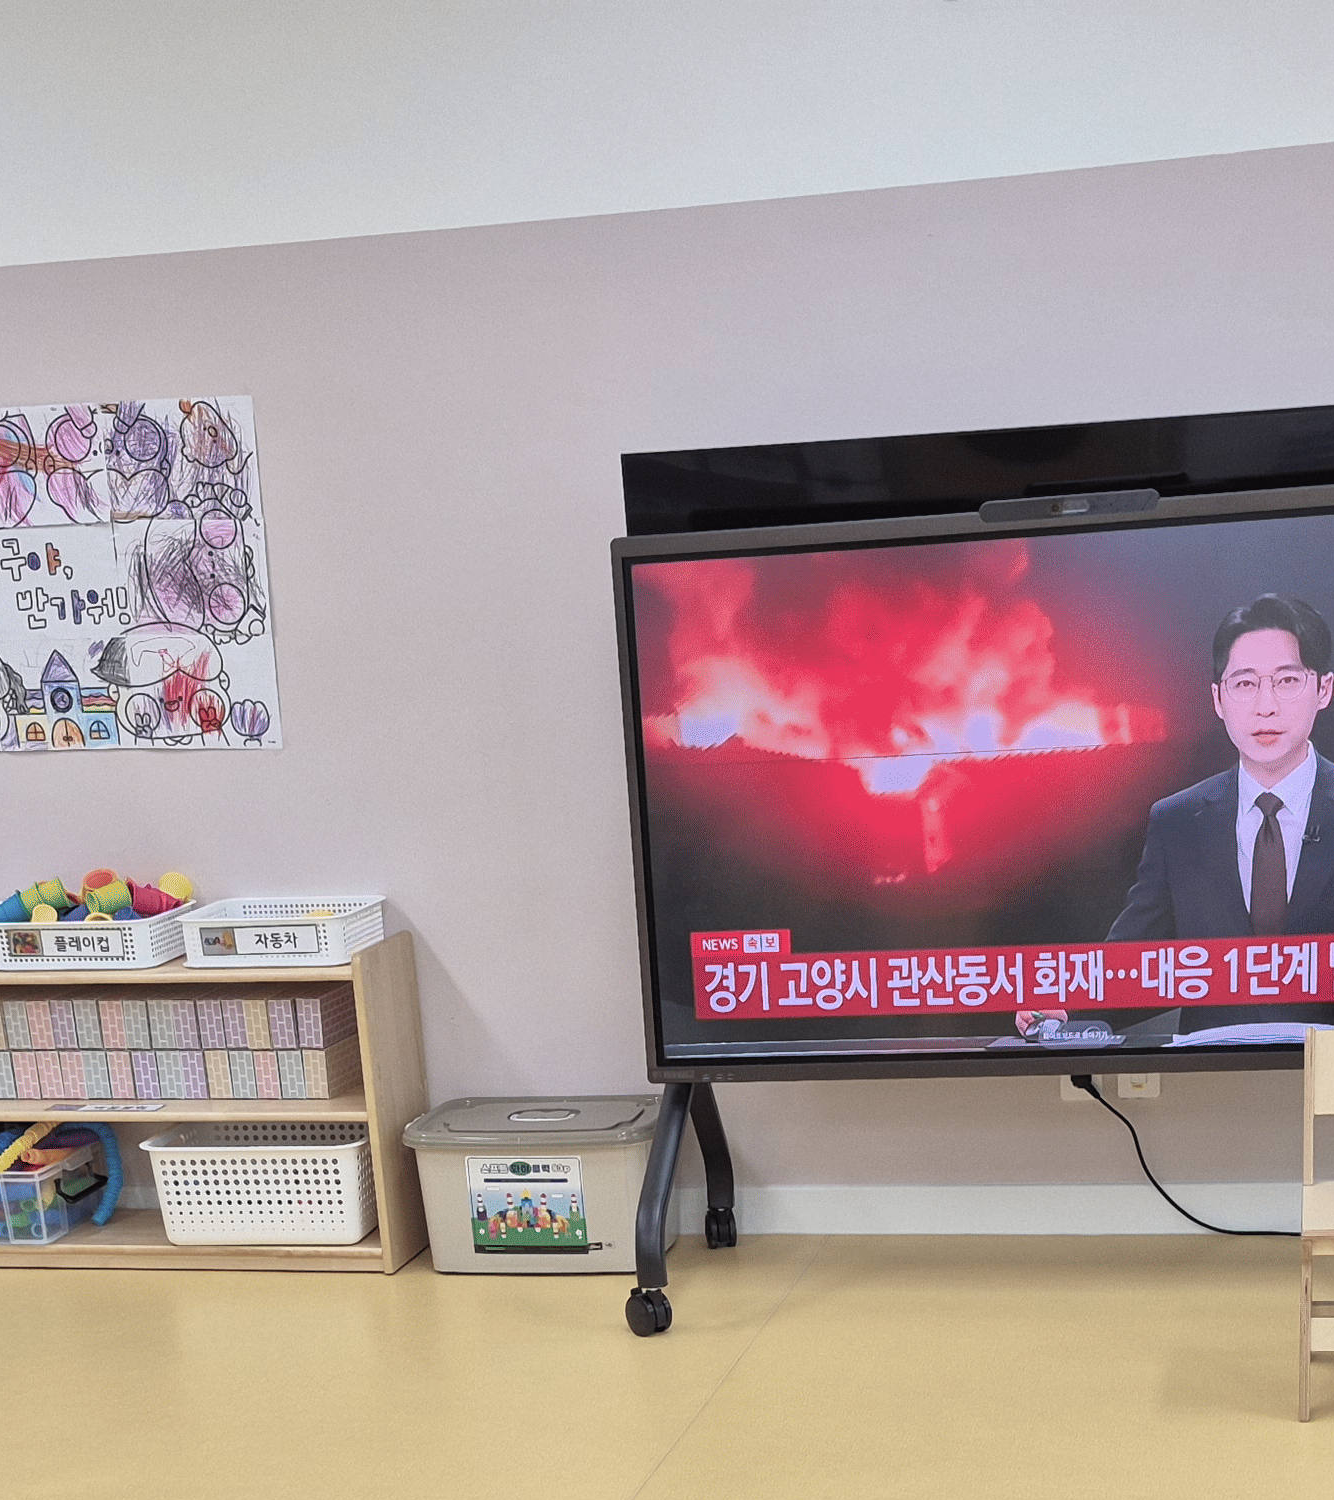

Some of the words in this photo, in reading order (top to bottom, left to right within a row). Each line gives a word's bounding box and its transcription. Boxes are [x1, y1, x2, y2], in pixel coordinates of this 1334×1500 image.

[17, 587, 131, 629] 반가워!
[53, 935, 110, 953] 플레이컵
[254, 932, 298, 949] 자동차
[702, 938, 739, 951] NEWS
[746, 935, 777, 951] 속보
[704, 962, 770, 1013] 경기
[778, 958, 878, 1010] 고양시
[887, 953, 1024, 1008] 관산동서
[1224, 941, 1318, 996] 1단계
